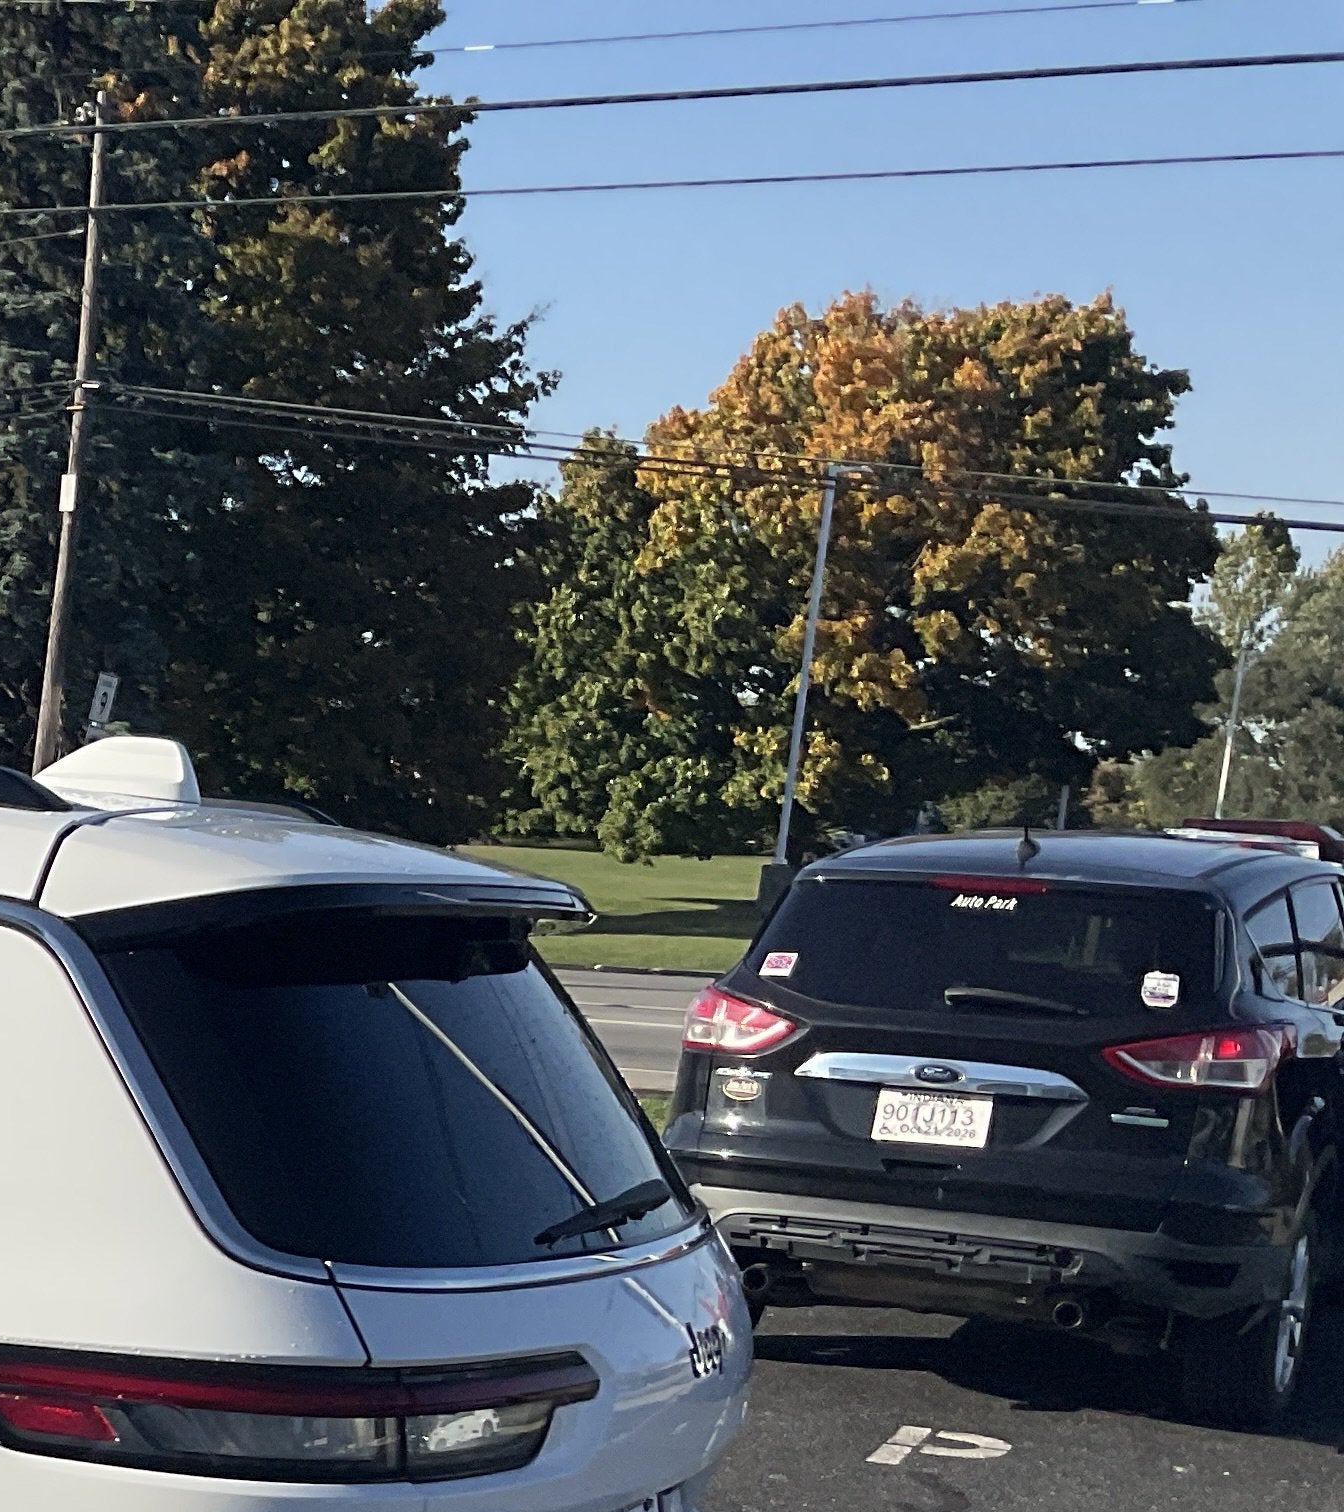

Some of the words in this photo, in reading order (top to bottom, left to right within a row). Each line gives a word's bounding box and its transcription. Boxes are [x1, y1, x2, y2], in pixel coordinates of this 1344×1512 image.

[950, 894, 985, 909] Auto
[983, 895, 1018, 911] Park
[882, 1103, 974, 1126] 901J113
[685, 1322, 726, 1379] Jeep
